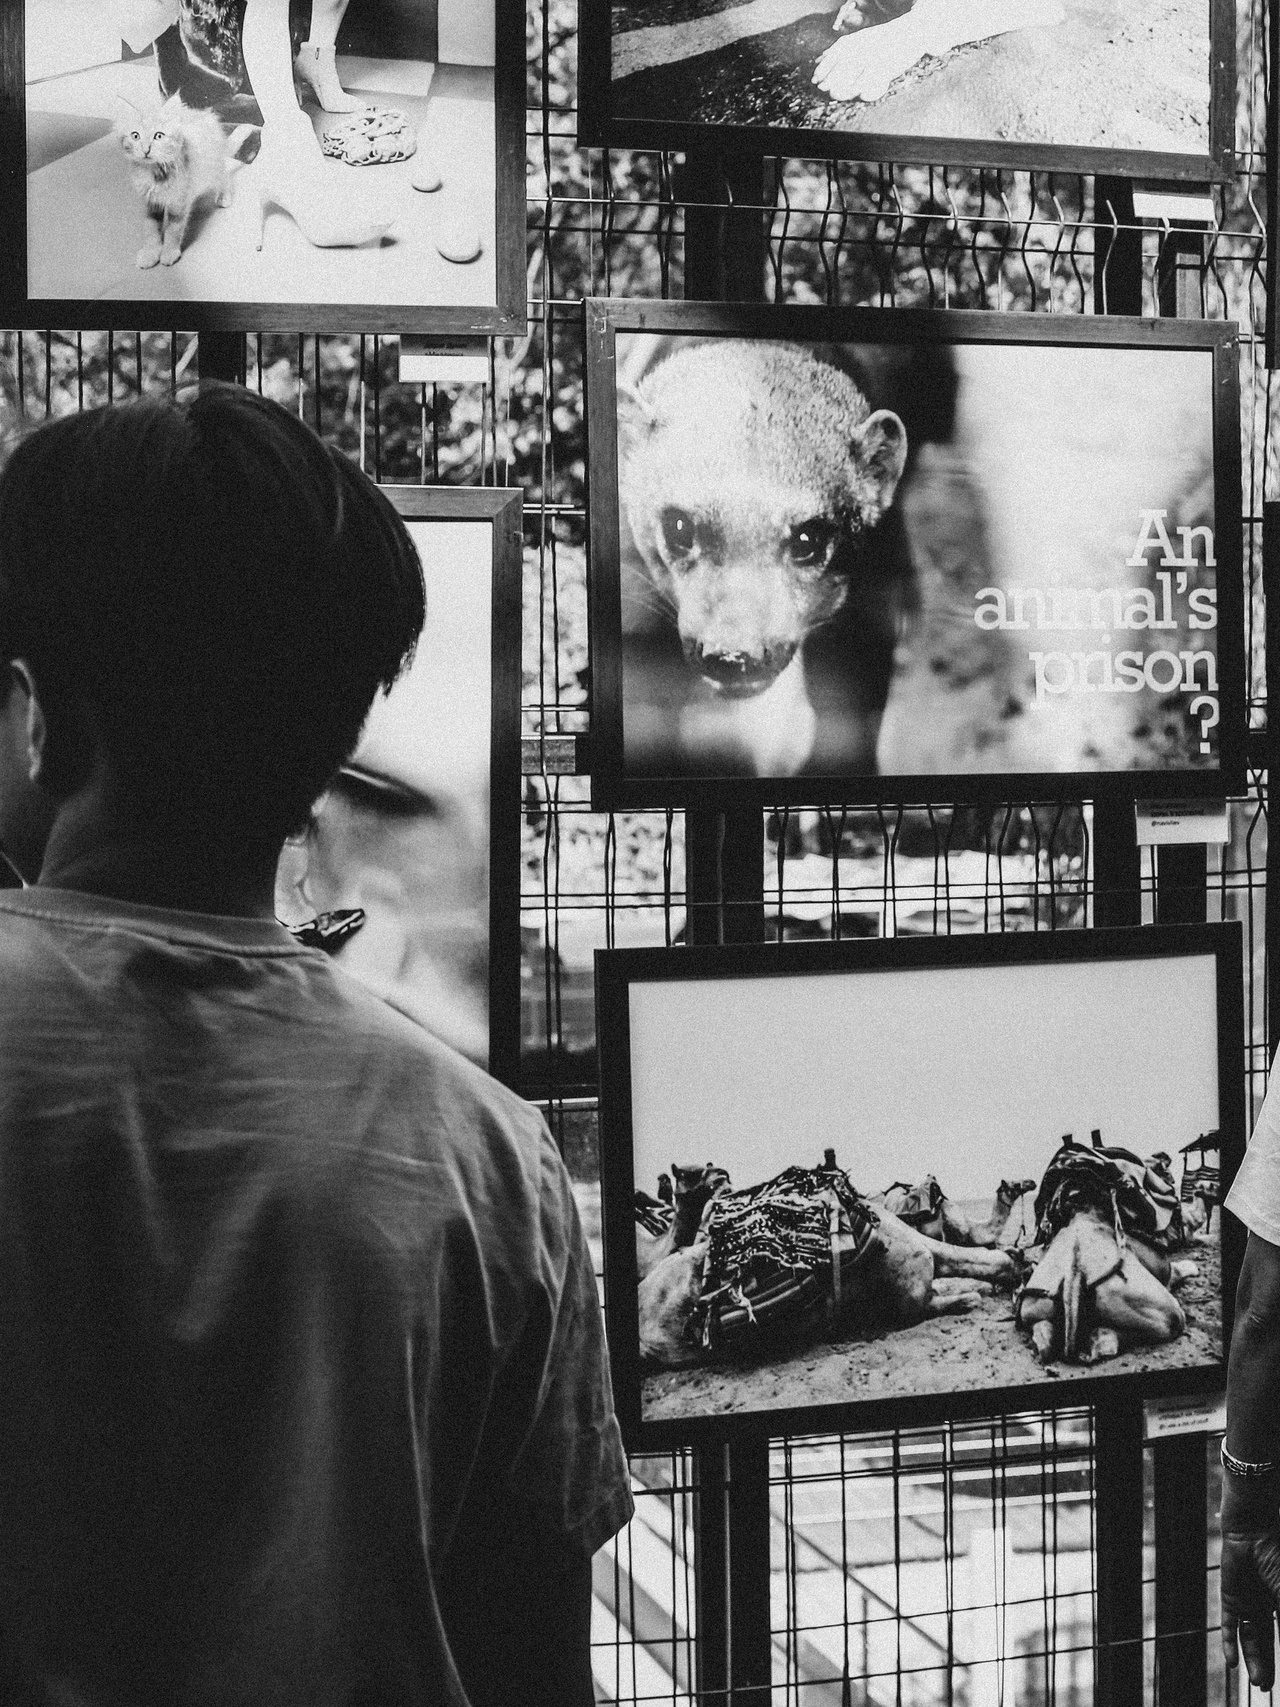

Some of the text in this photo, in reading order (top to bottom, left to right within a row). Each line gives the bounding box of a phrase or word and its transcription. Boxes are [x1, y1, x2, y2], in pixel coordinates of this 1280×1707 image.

[1125, 508, 1217, 567] An
[974, 571, 1218, 631] animal's
[1028, 633, 1219, 710] prison
[1189, 695, 1220, 754] ?
